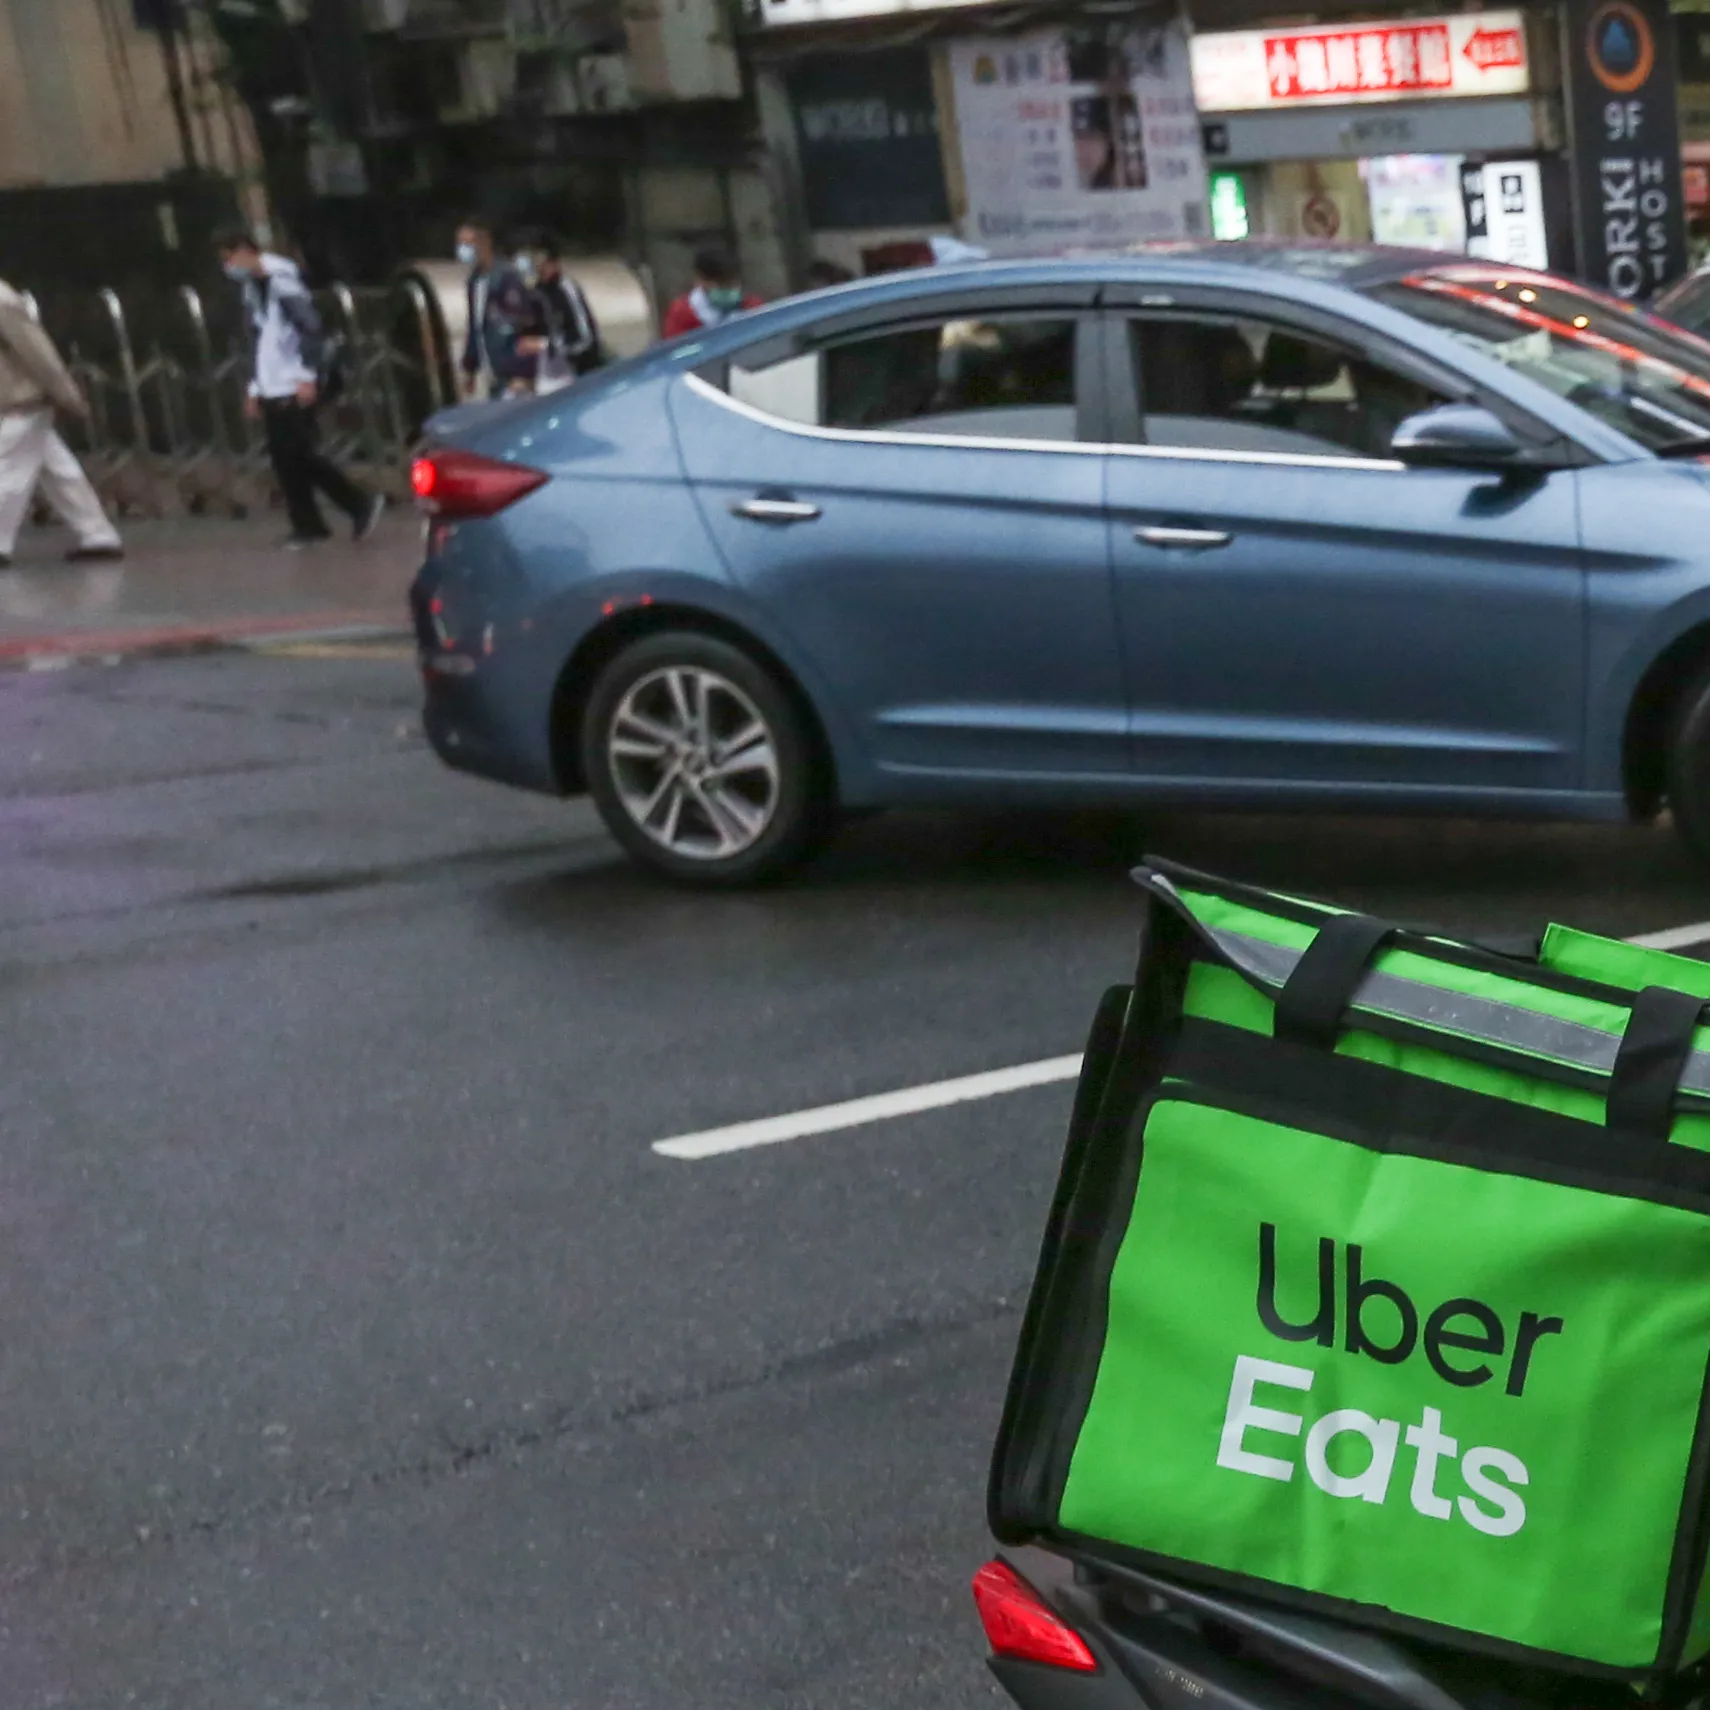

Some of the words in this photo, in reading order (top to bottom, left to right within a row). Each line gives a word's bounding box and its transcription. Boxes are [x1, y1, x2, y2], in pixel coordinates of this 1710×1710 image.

[1603, 100, 1644, 142] 9F
[1600, 157, 1643, 298] ORKI
[1639, 157, 1668, 297] HOST
[1256, 1221, 1564, 1397] Uber
[1216, 1354, 1530, 1537] Eats
